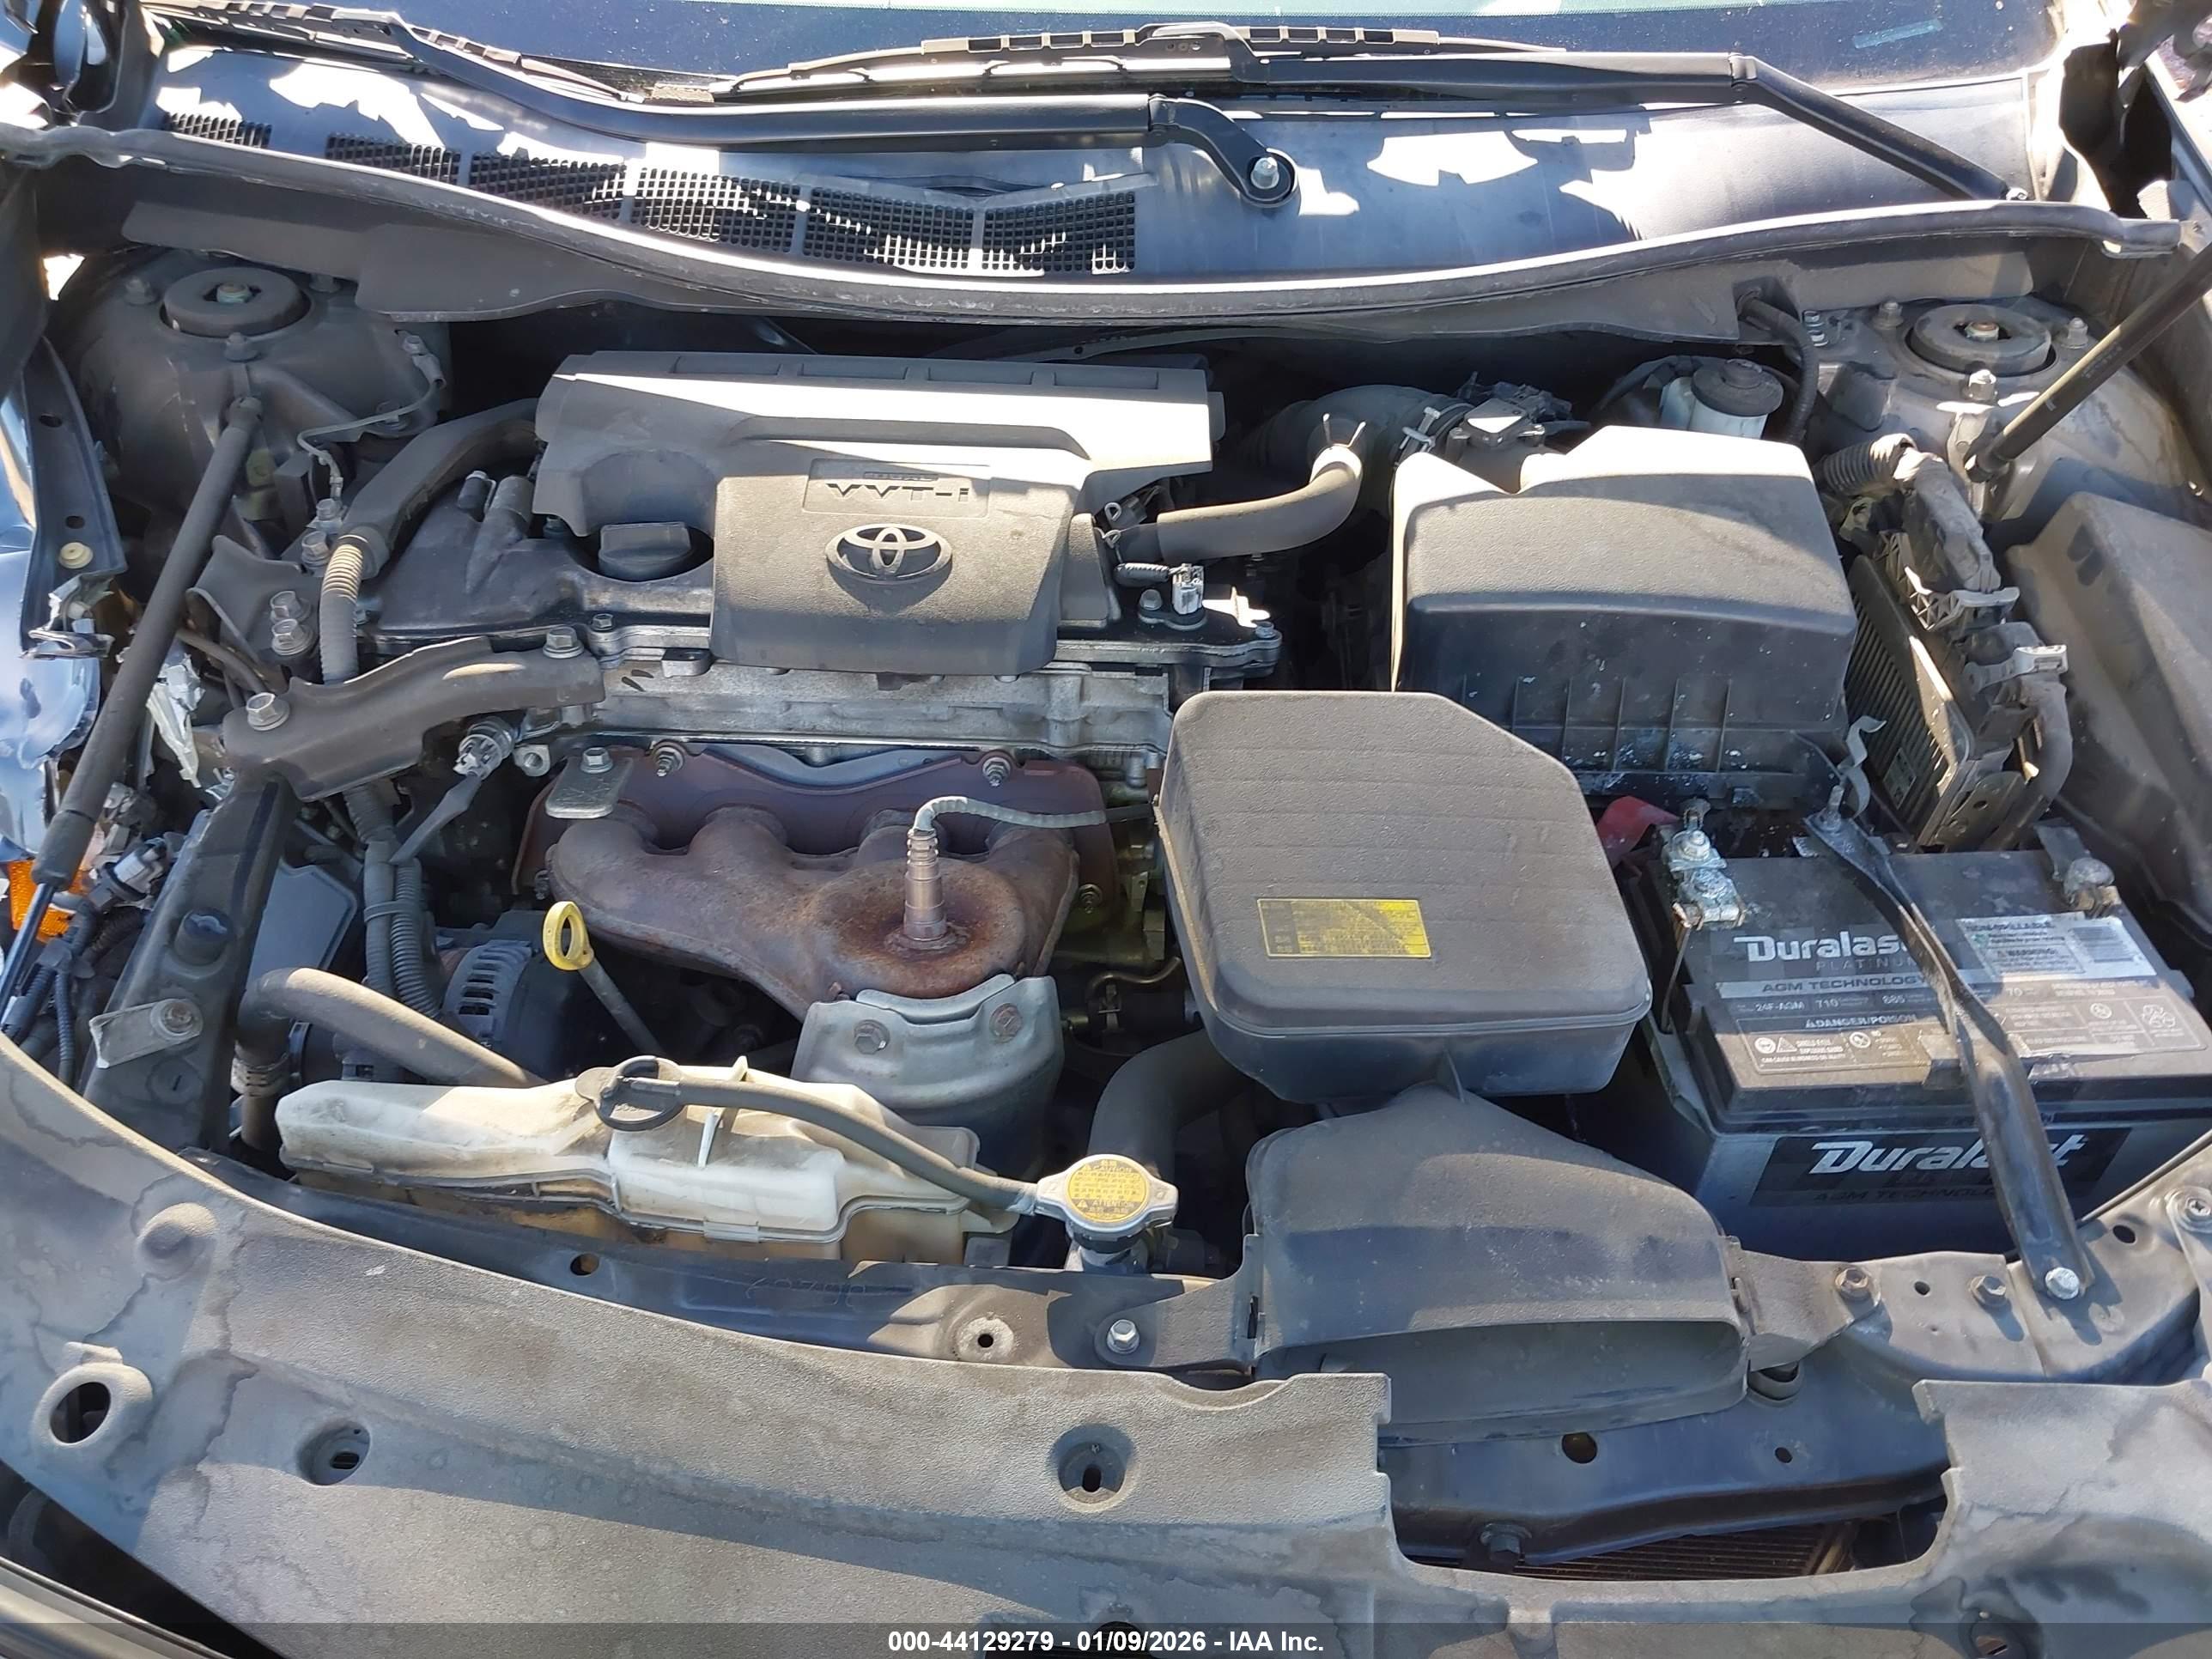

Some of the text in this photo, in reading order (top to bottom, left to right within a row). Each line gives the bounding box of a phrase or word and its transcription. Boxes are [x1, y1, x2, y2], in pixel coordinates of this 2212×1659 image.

[826, 483, 969, 502] VVT-i
[1762, 983, 1803, 993] AGM
[1808, 1133, 2089, 1175] Duralt
